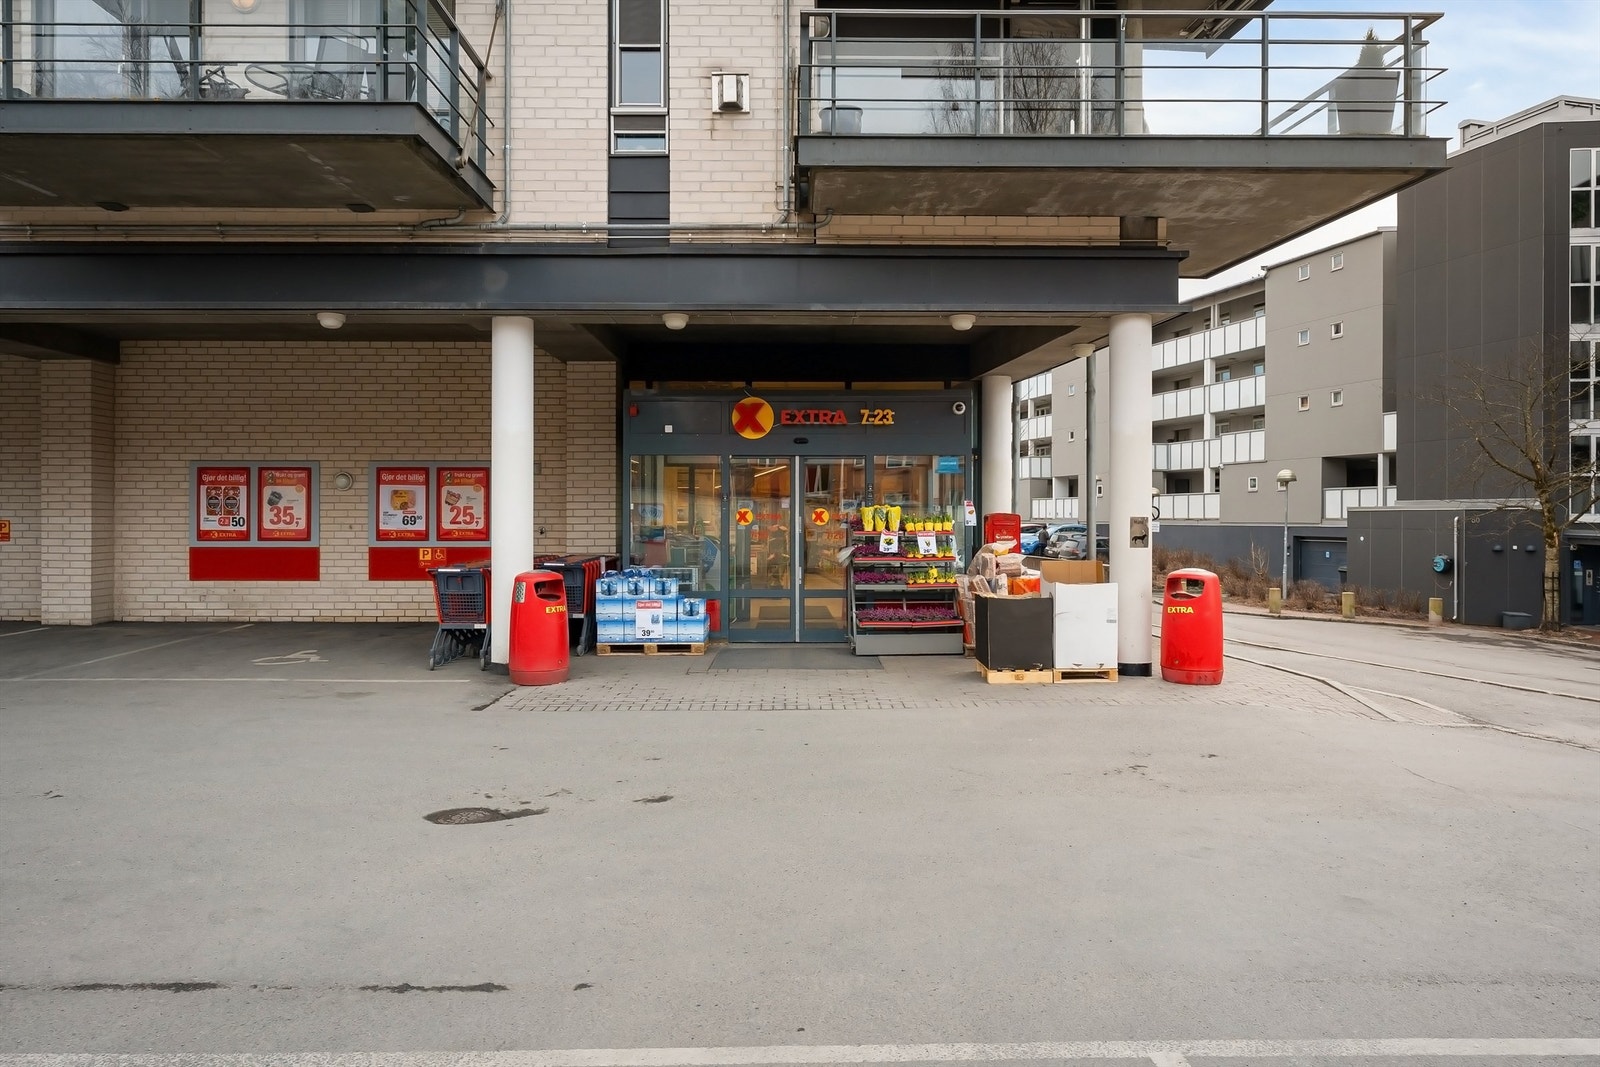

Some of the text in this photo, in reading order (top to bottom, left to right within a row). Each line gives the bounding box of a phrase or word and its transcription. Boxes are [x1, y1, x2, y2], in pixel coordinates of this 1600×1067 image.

[780, 409, 848, 425] EXTRA
[860, 409, 893, 425] 7-23
[381, 473, 395, 482] Gjør
[395, 473, 407, 481] det
[231, 516, 246, 527] 50
[422, 549, 430, 559] P
[1167, 606, 1194, 614] EXTRA
[641, 629, 651, 637] 39
